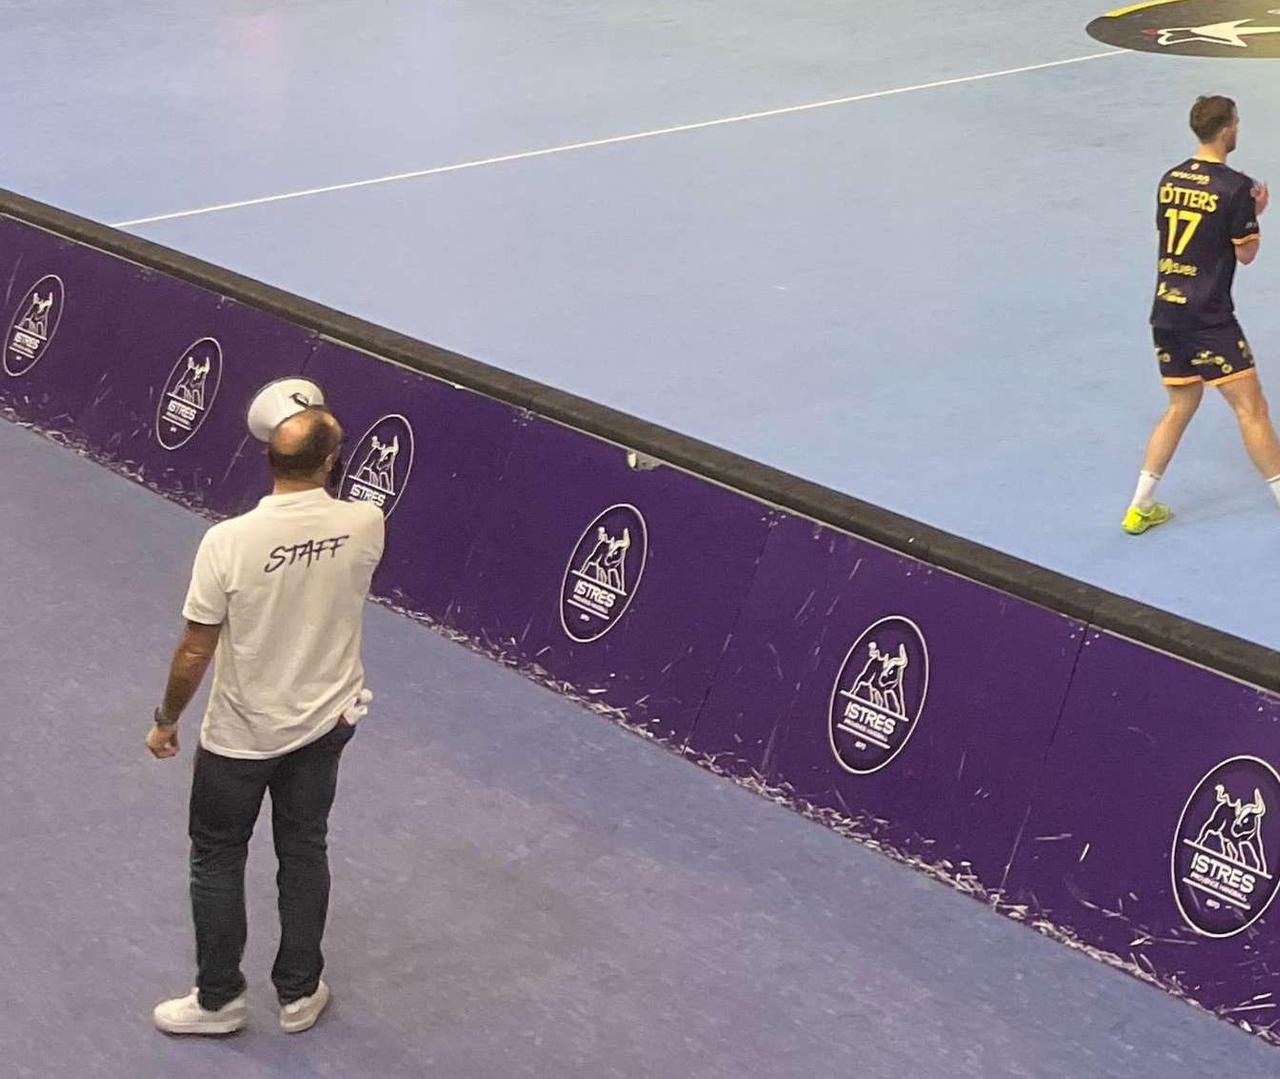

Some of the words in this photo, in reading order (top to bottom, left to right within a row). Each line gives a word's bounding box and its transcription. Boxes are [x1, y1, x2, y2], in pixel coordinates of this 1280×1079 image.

[1163, 207, 1202, 256] 17
[167, 400, 198, 422] ISTRES
[350, 483, 388, 508] ISTRES
[264, 534, 350, 574] STAFF
[574, 580, 616, 608] ISTRES
[844, 701, 896, 735] ISTRES
[1191, 852, 1256, 894] ISTRES
